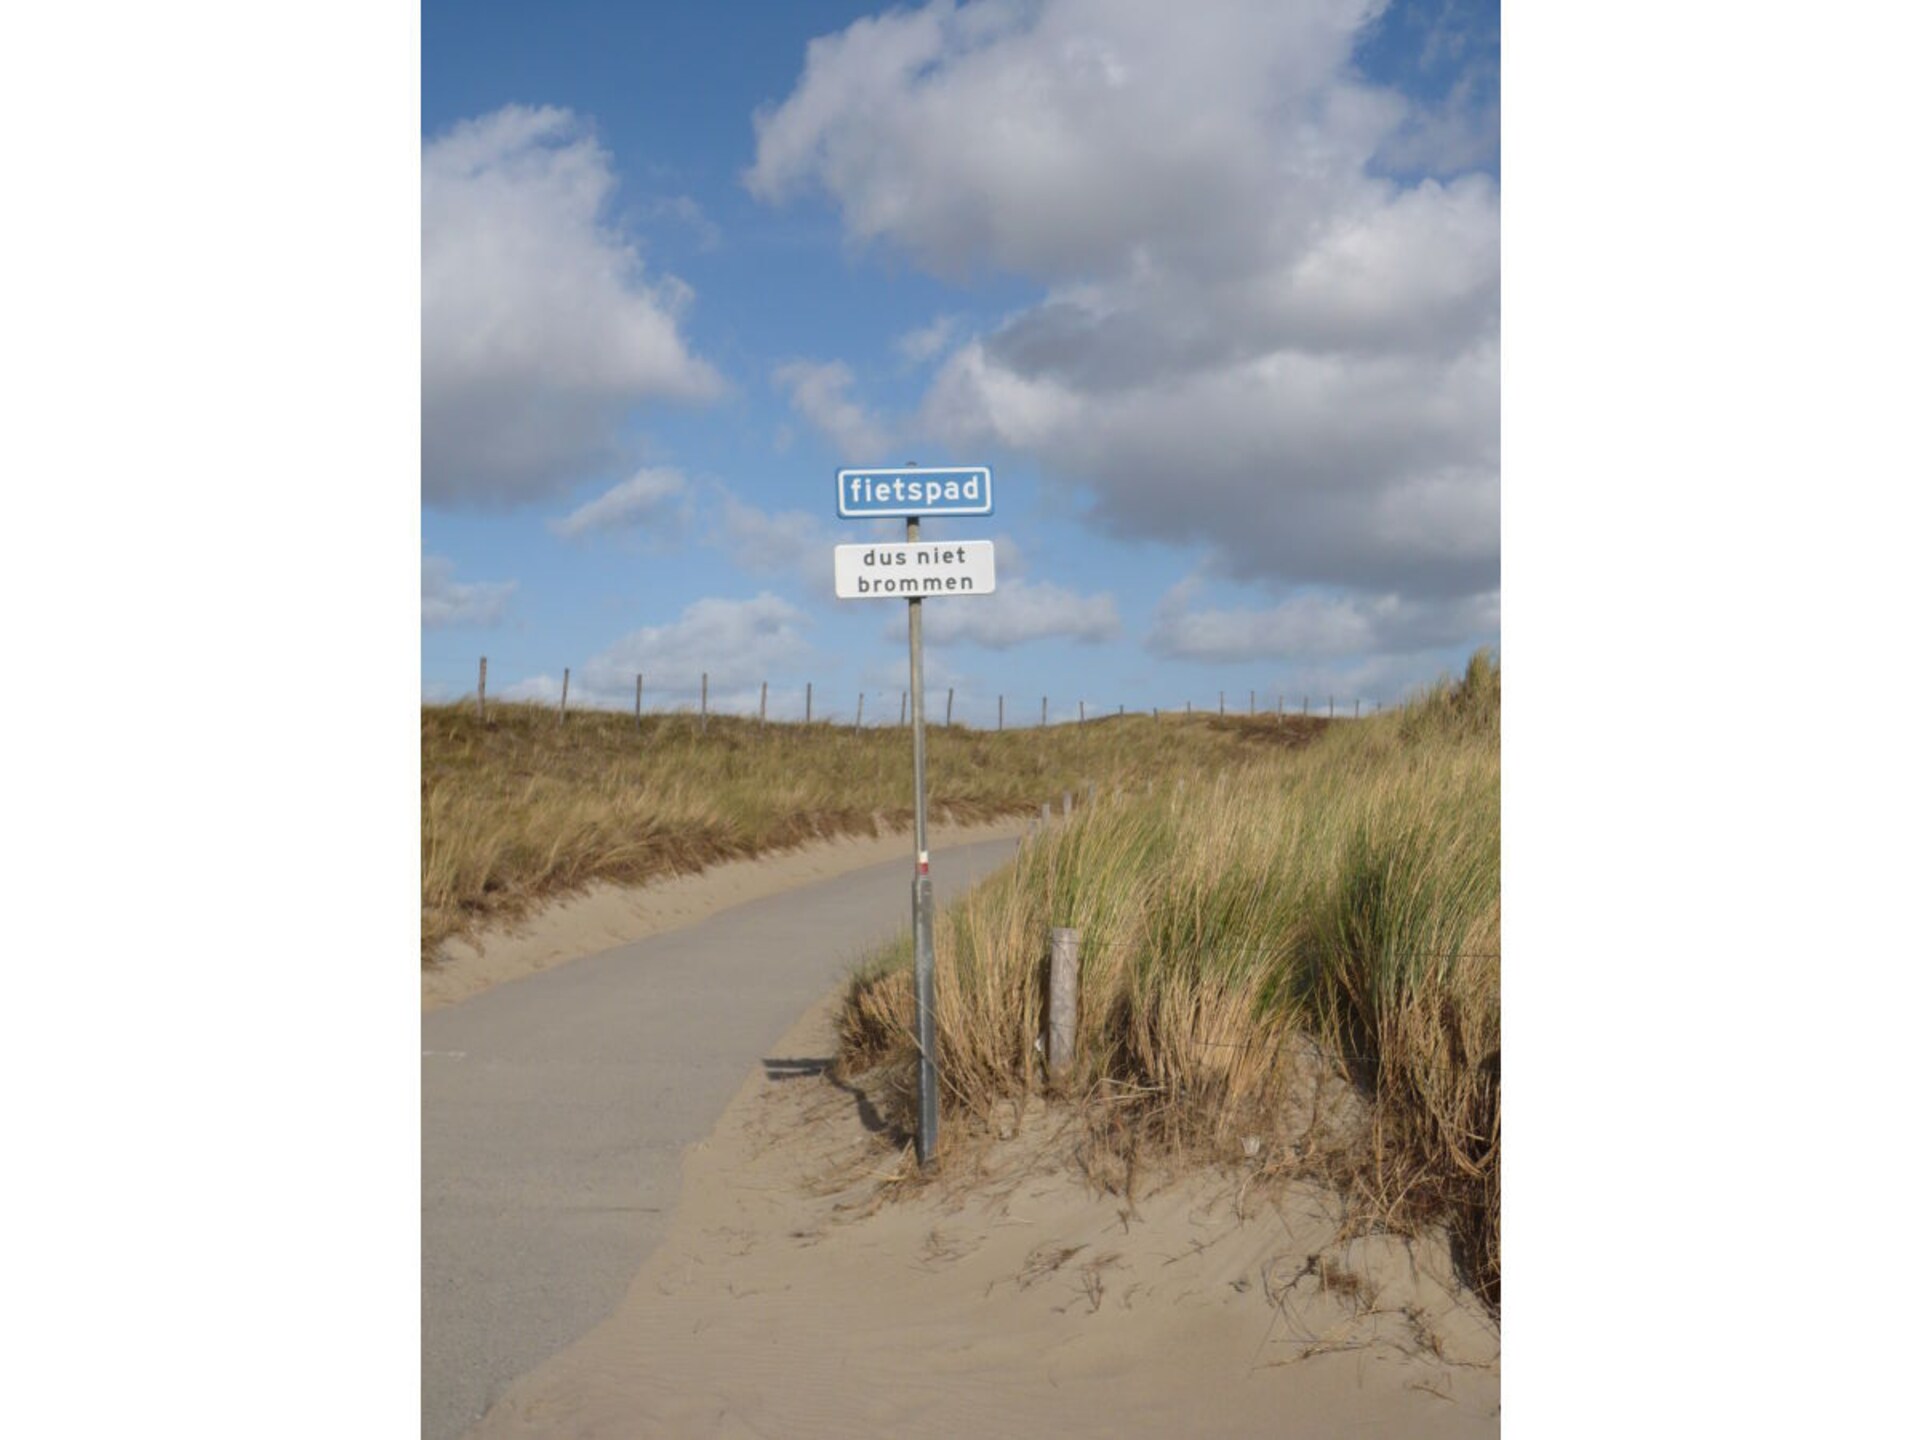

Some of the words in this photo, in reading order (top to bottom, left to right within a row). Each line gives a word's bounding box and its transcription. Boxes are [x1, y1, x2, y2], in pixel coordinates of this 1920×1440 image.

[850, 476, 979, 505] fietspad
[863, 549, 907, 566] dus
[917, 546, 966, 564] niet
[858, 576, 973, 593] brommen
